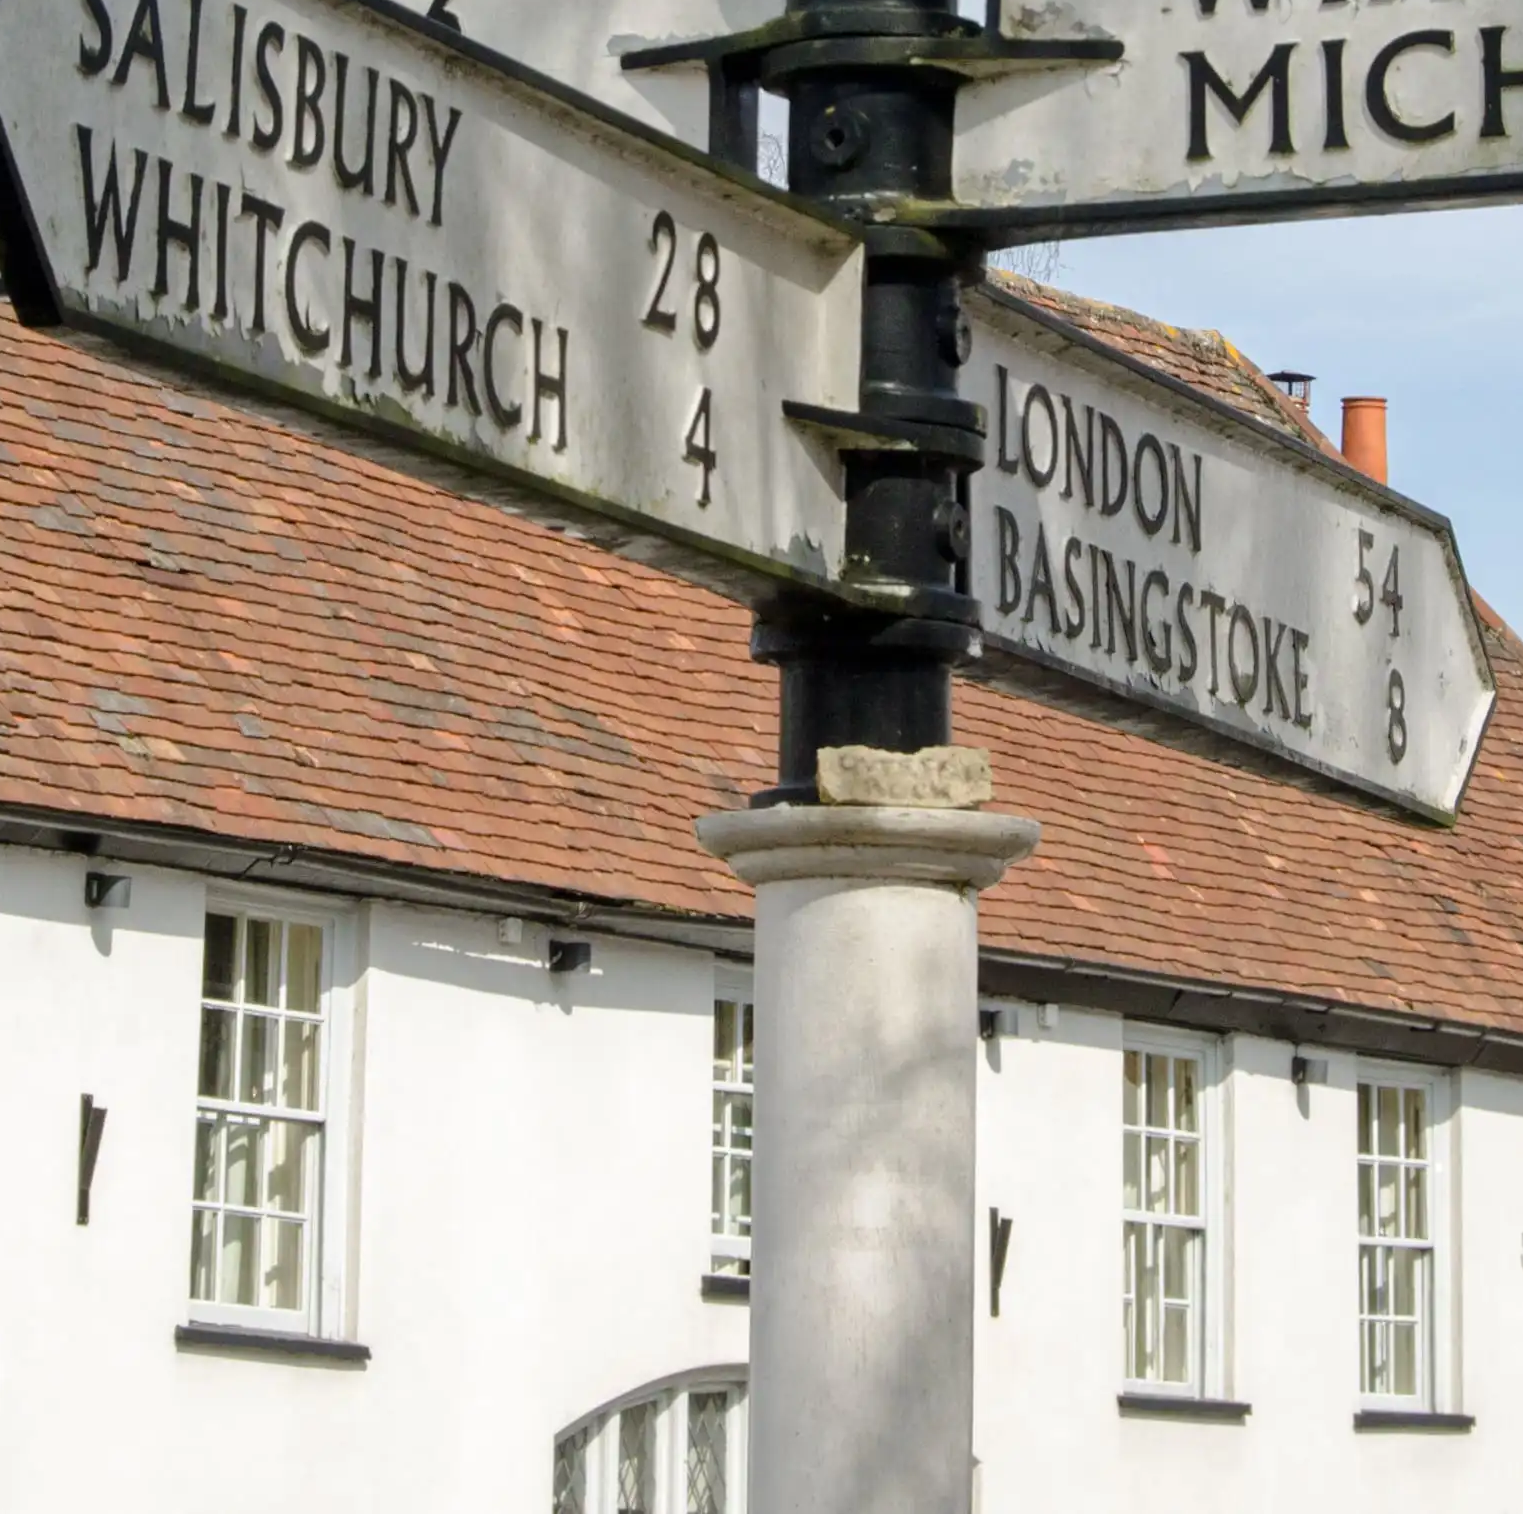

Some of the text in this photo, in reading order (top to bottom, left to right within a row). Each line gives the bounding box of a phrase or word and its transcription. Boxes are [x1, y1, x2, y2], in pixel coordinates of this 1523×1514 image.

[76, 124, 716, 508] WHITCHURCH 4
[642, 210, 721, 350] 28
[995, 365, 1403, 638] LONDON 54
[995, 506, 1407, 765] BASINGSTOKE 8
